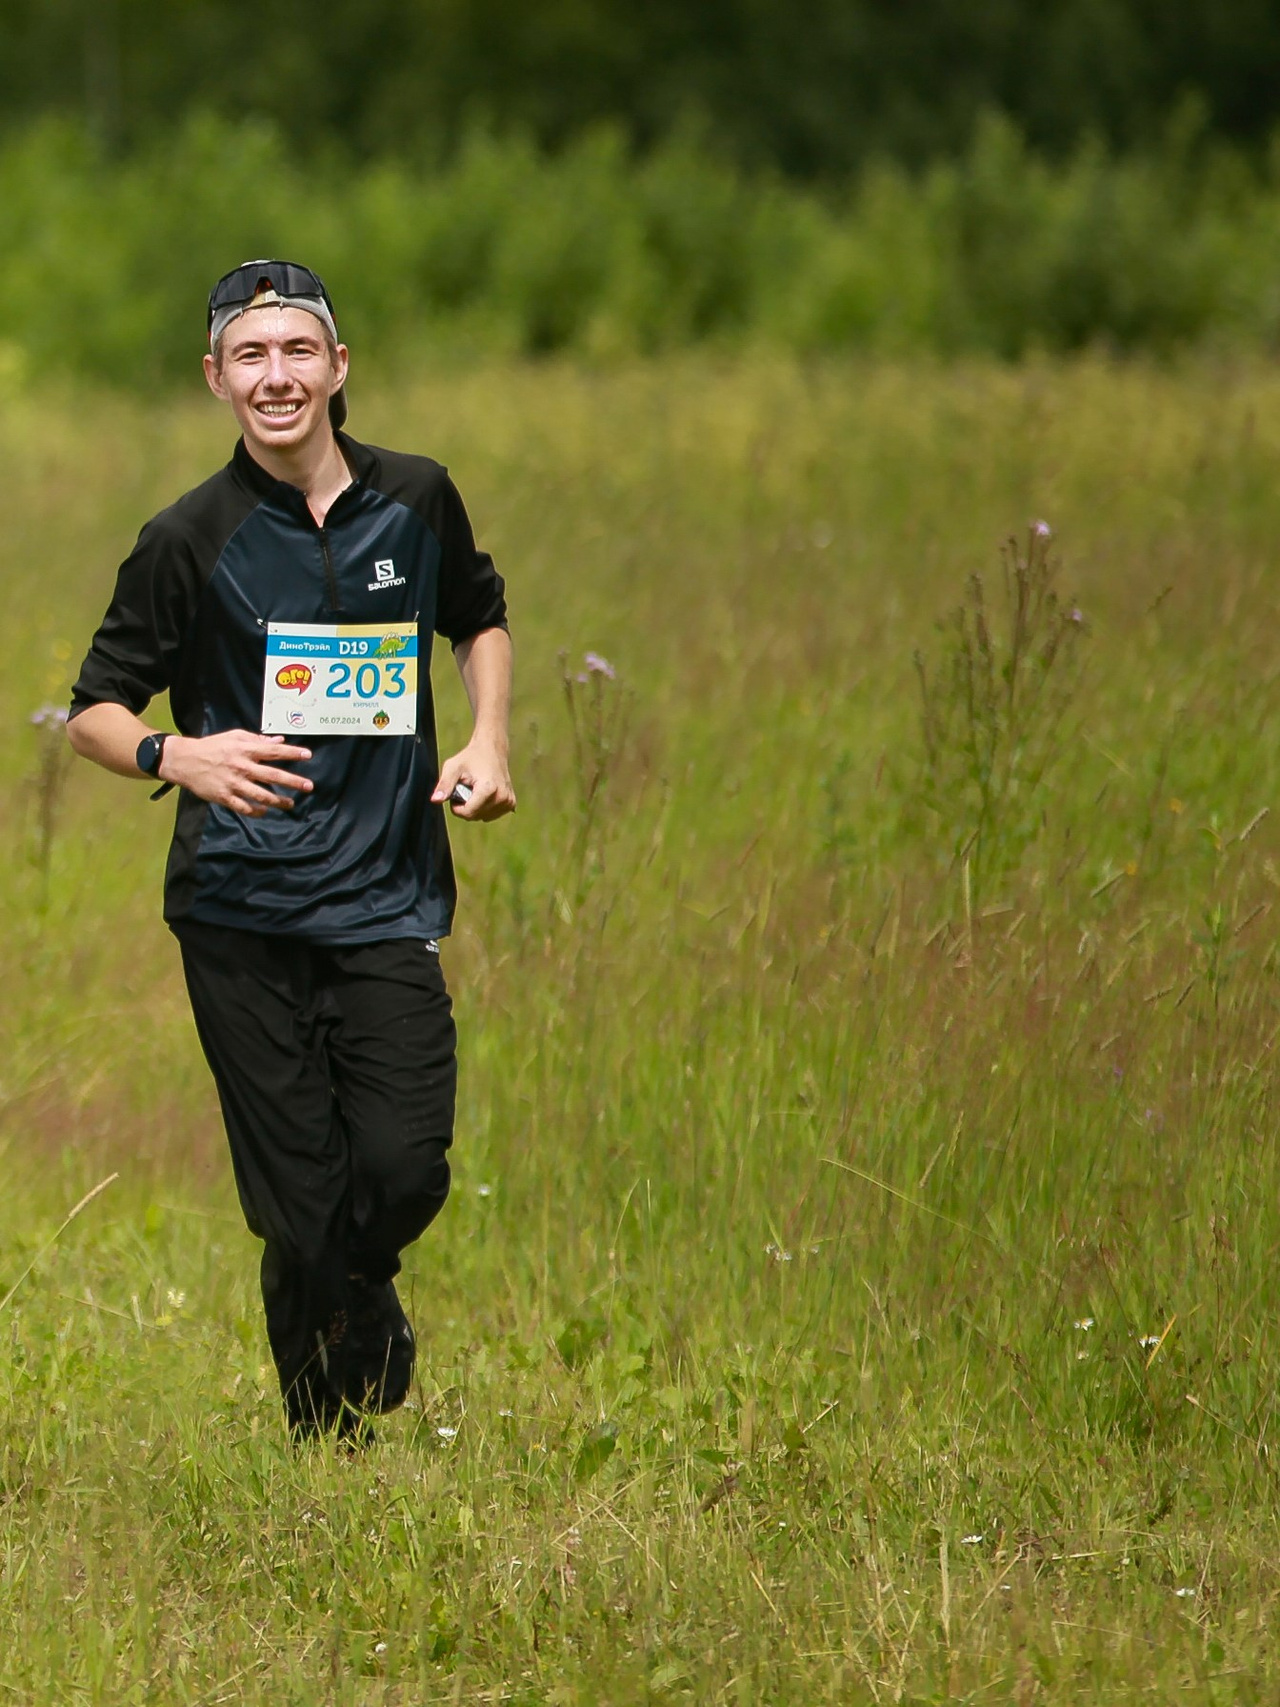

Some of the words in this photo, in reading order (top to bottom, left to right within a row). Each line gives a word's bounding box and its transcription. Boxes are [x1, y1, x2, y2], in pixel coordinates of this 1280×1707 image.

[279, 641, 331, 652] ДиноТрэйл
[339, 641, 368, 655] D19
[325, 662, 406, 699] 203
[319, 716, 361, 724] 06.07.2024
